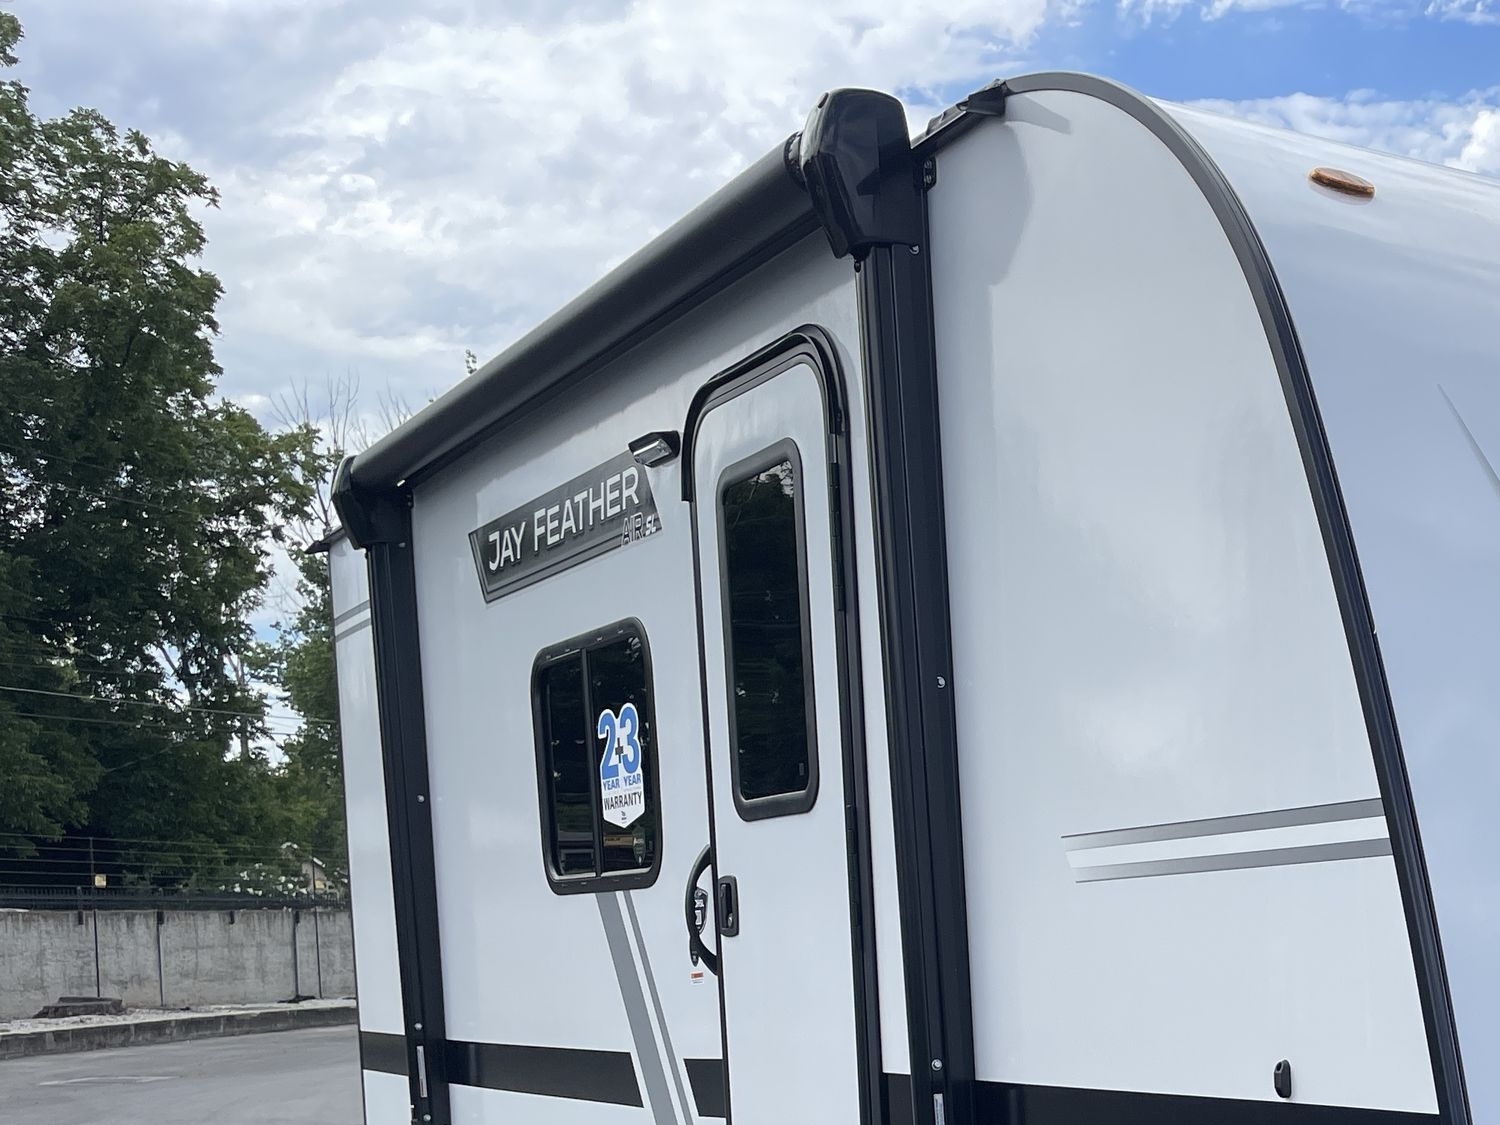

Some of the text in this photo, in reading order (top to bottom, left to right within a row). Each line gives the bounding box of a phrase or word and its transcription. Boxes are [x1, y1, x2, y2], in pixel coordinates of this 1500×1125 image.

[489, 466, 640, 572] JAY FEATHER
[621, 511, 644, 549] AIR
[602, 773, 641, 791] YEAR YEAR
[603, 791, 642, 811] WARRANTY
